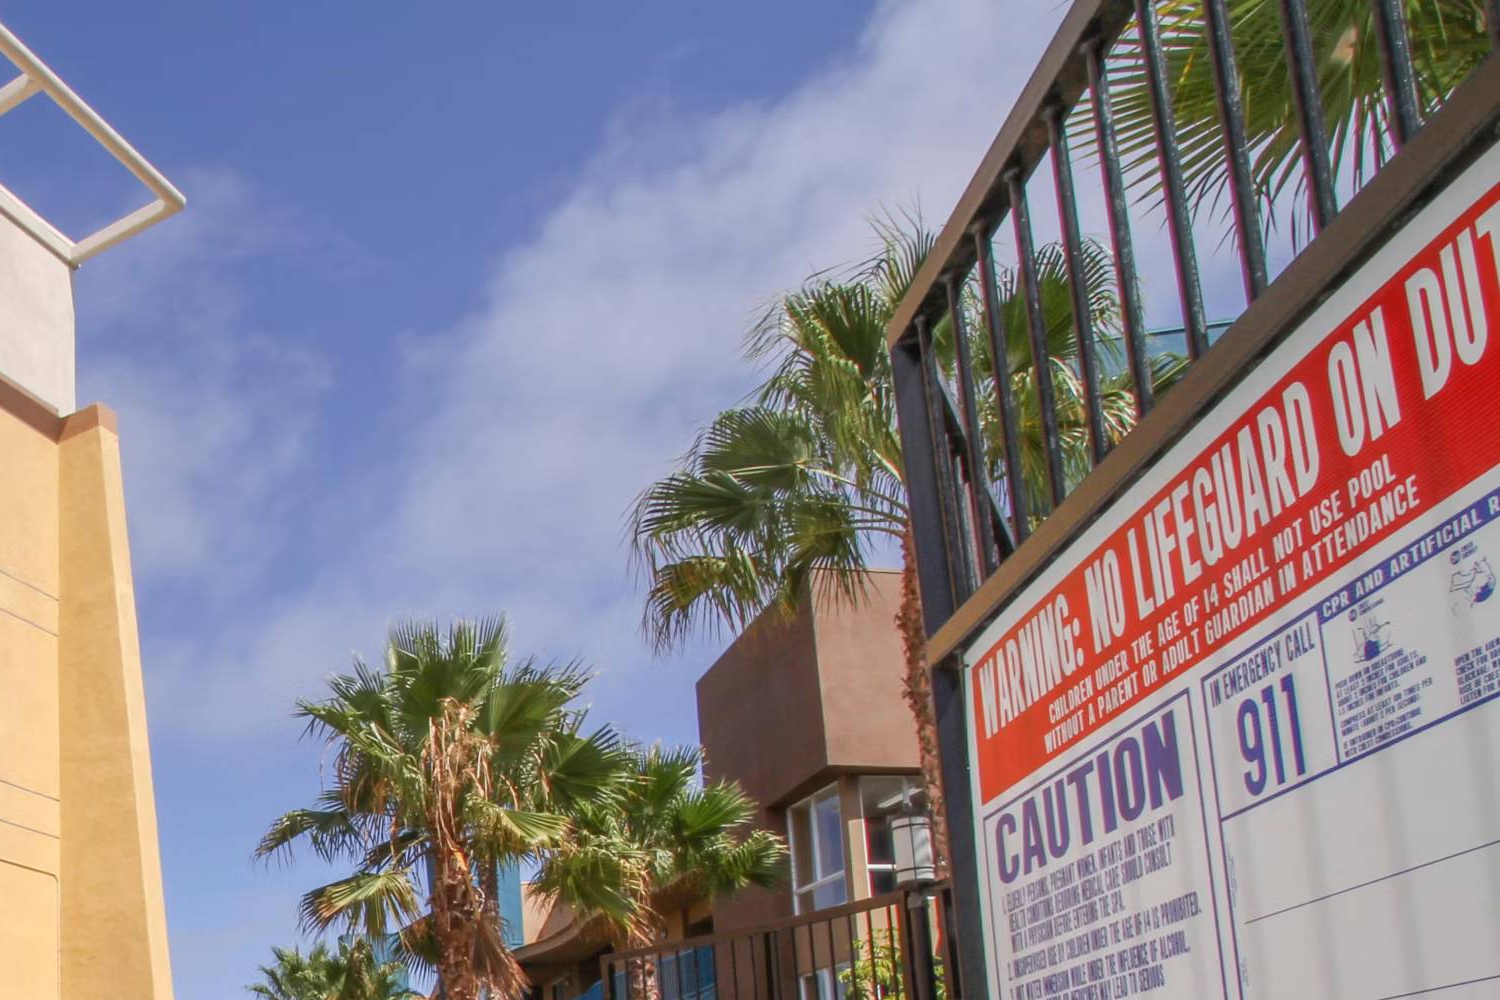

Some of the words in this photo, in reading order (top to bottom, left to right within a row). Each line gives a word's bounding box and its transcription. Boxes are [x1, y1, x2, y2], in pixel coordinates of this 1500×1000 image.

[979, 591, 1084, 739] WARNING:
[1085, 549, 1127, 654] NO
[1128, 381, 1320, 615] LIFEGUARD
[1328, 305, 1401, 457] ON
[1049, 681, 1093, 723] CHILDREN
[1095, 651, 1129, 687] UNDER
[1131, 632, 1153, 664] THE
[1158, 611, 1180, 646] AGE
[1184, 596, 1198, 626] OF
[1204, 587, 1219, 612] 14
[1223, 548, 1269, 598] SHALL
[1272, 518, 1303, 562] NOT
[1309, 490, 1343, 535] USE
[1348, 454, 1396, 508] POOL
[1322, 590, 1349, 618] CPR
[1355, 569, 1384, 600] AND
[1390, 509, 1482, 577] ARTIFICIAL
[1044, 716, 1084, 753] WITHOUT
[1088, 704, 1096, 725] A
[1097, 674, 1139, 718] PARENT
[1142, 660, 1157, 687] OR
[1162, 629, 1200, 675] ADULT
[1205, 576, 1275, 645] GUARDIAN
[1279, 561, 1297, 595] IN
[1302, 475, 1420, 580] ATTENDANCE
[1209, 680, 1221, 707] IN
[1223, 637, 1283, 700] EMERGENCY
[1285, 622, 1315, 662] CALL
[996, 710, 1183, 884] CAUTION
[1237, 673, 1306, 796] 911
